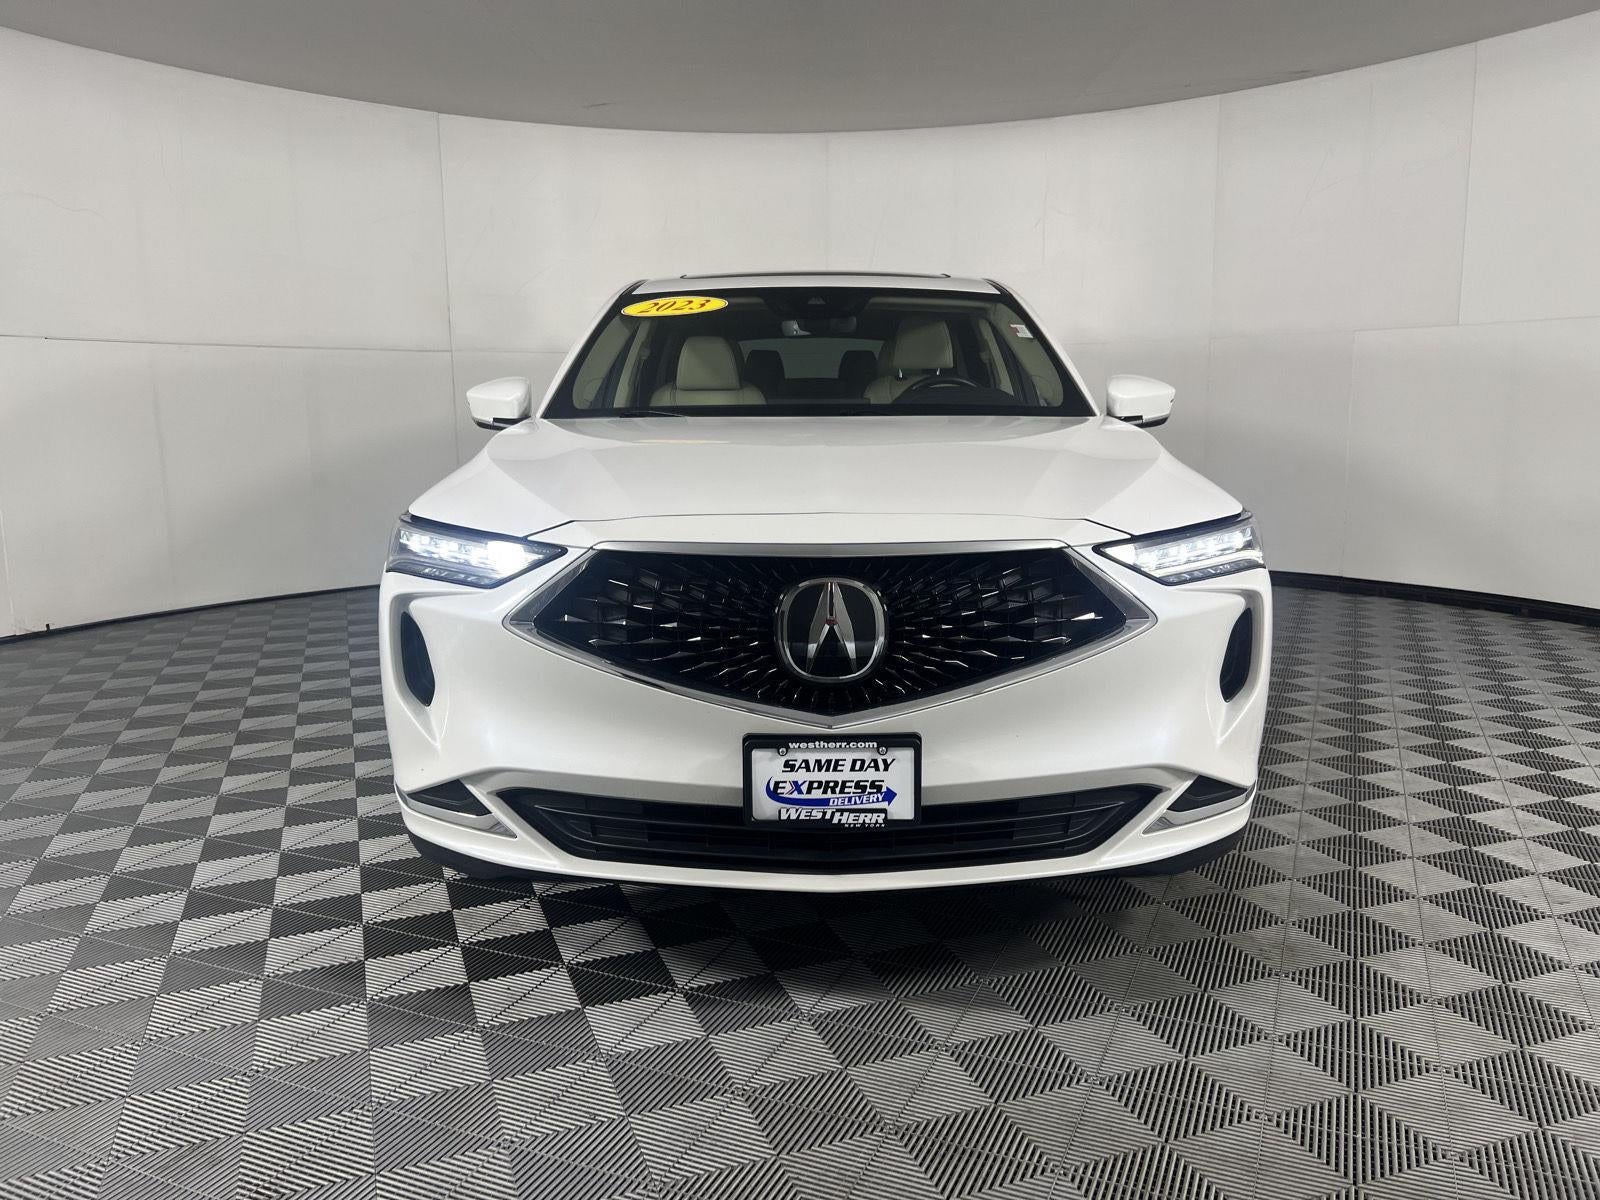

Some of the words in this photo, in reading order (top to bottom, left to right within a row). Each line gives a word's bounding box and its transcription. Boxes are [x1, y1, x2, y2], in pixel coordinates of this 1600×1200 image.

[637, 299, 712, 314] 2023
[788, 740, 878, 749] westherr.com
[782, 758, 846, 773] SAME
[849, 758, 896, 773] DAY
[772, 779, 885, 795] EXPRESS
[829, 793, 885, 807] DELIVERY
